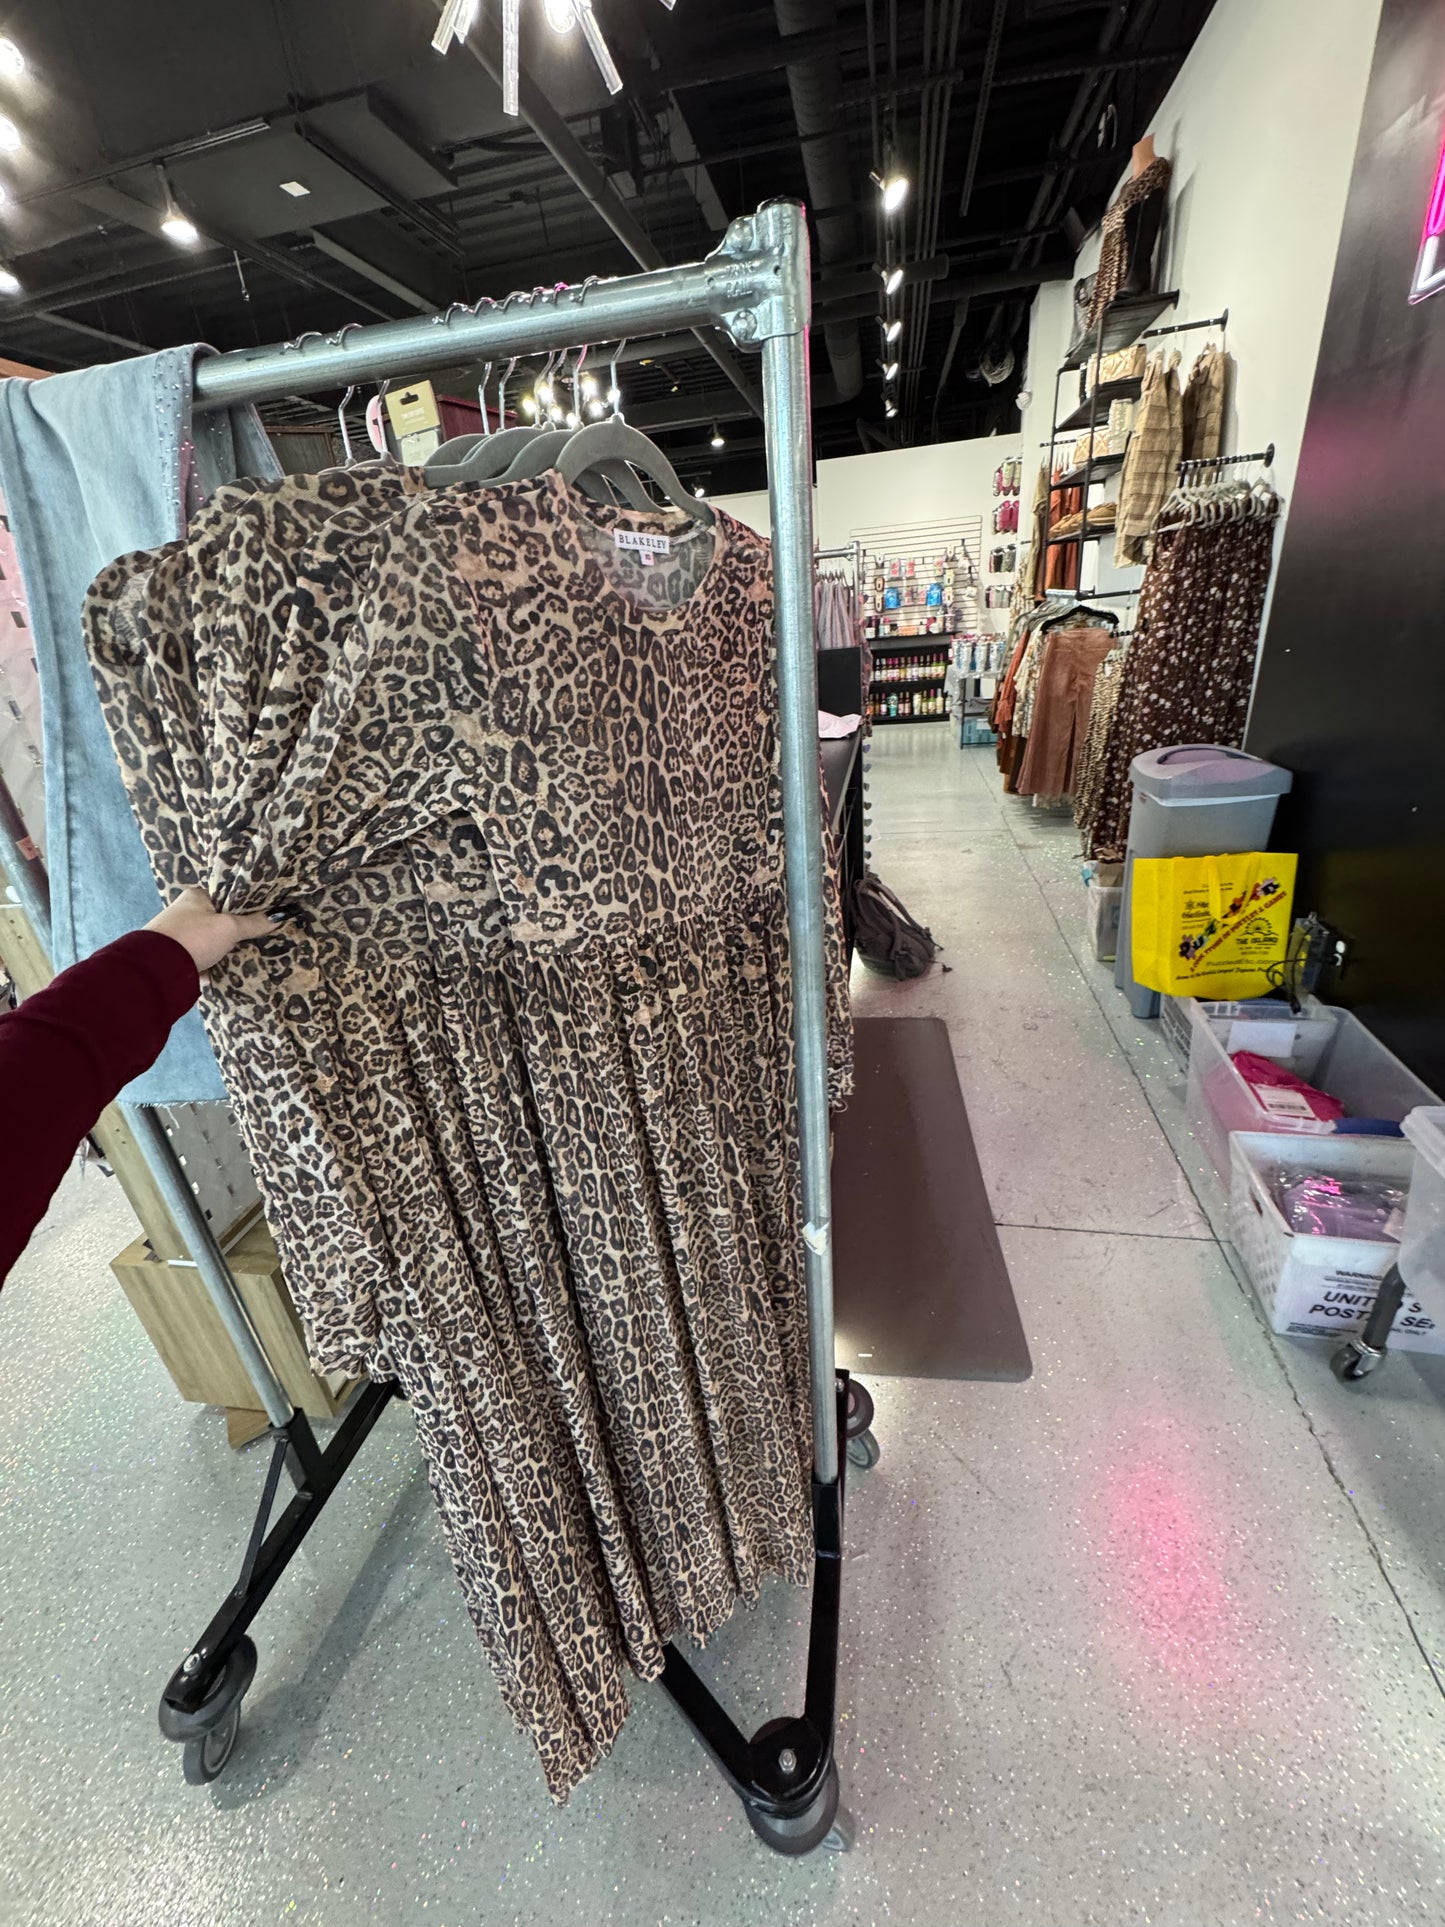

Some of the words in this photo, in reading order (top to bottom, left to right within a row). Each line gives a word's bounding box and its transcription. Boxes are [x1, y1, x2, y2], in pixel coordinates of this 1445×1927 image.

[618, 534, 667, 549] BLAKELEY
[1336, 1270, 1383, 1281] WARNING
[1324, 1291, 1377, 1307] UNIT
[1309, 1304, 1372, 1321] POST
